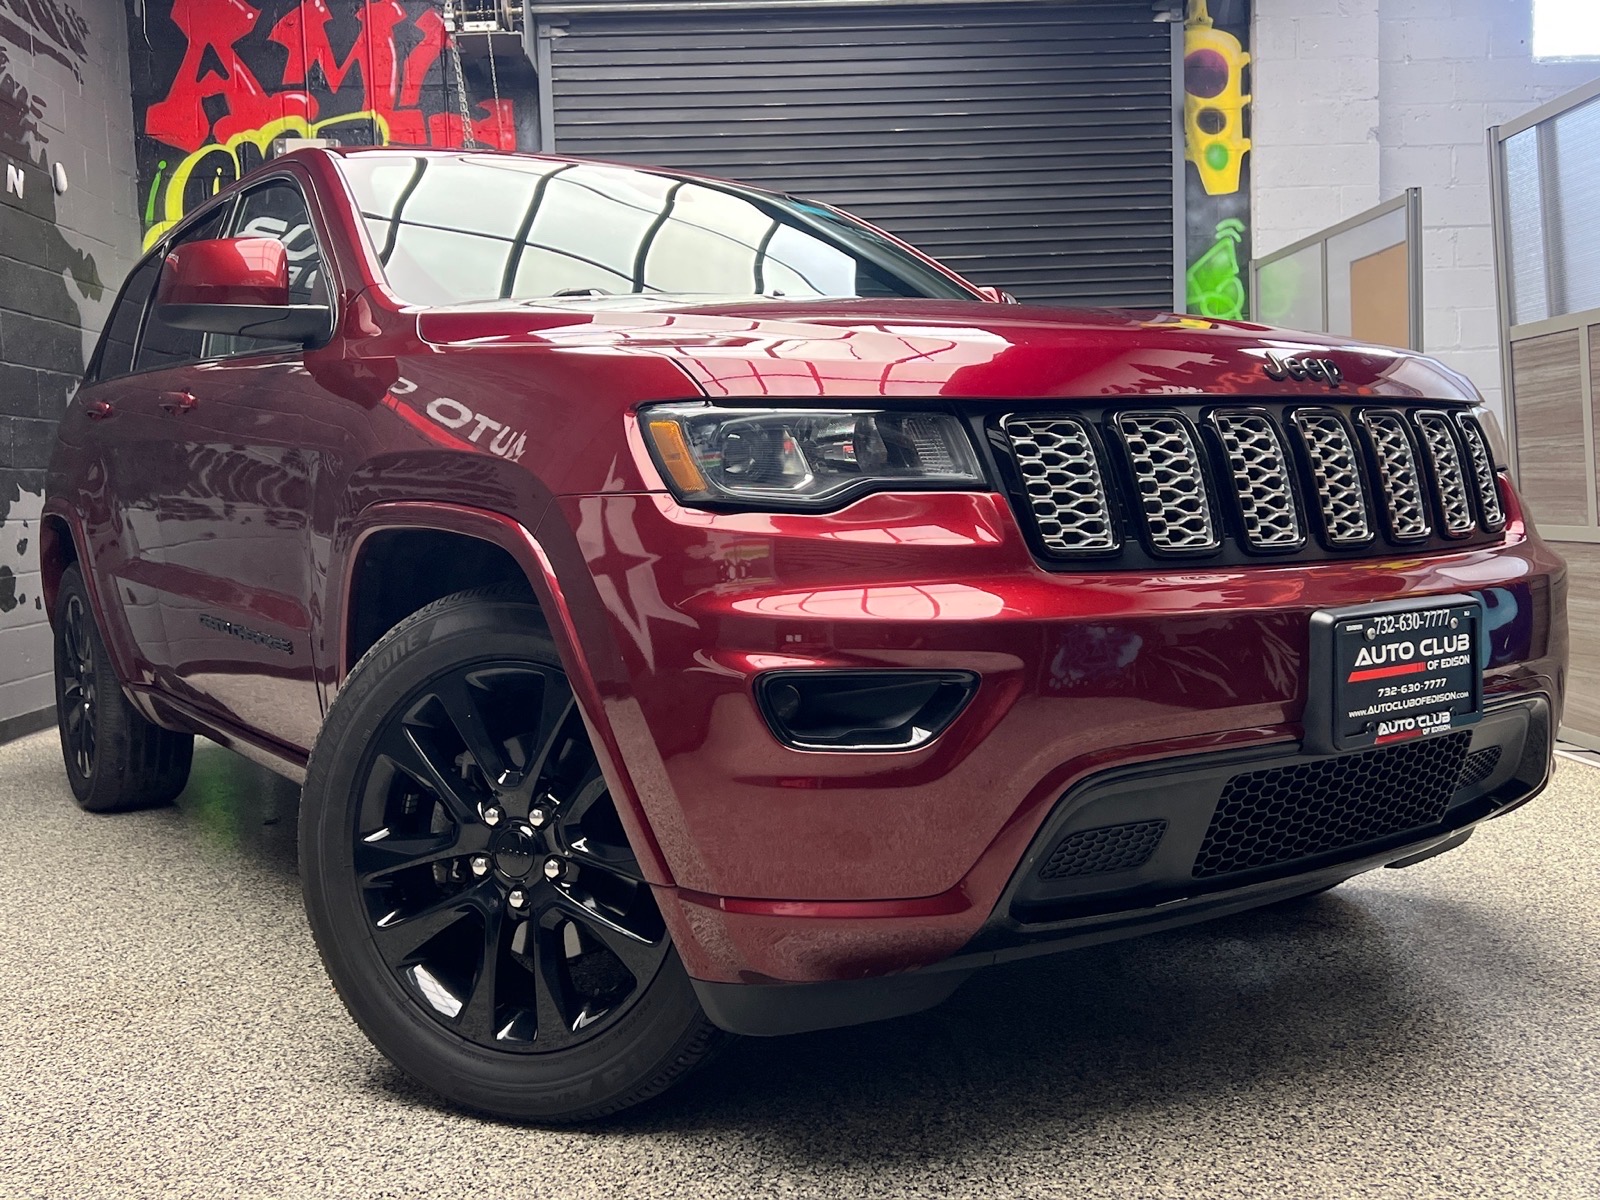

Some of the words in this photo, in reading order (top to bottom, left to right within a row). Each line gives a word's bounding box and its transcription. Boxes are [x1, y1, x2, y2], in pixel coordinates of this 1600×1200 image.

[1263, 351, 1344, 388] Jeep
[1374, 609, 1450, 635] 732-630-7777
[1354, 641, 1415, 667] AUTO
[1420, 633, 1470, 656] CLUB
[1427, 660, 1439, 671] OF
[1441, 655, 1470, 669] EDISON
[1377, 678, 1447, 698] 732-630-7777
[1378, 718, 1415, 736] AUTO
[1416, 711, 1451, 727] CLUB
